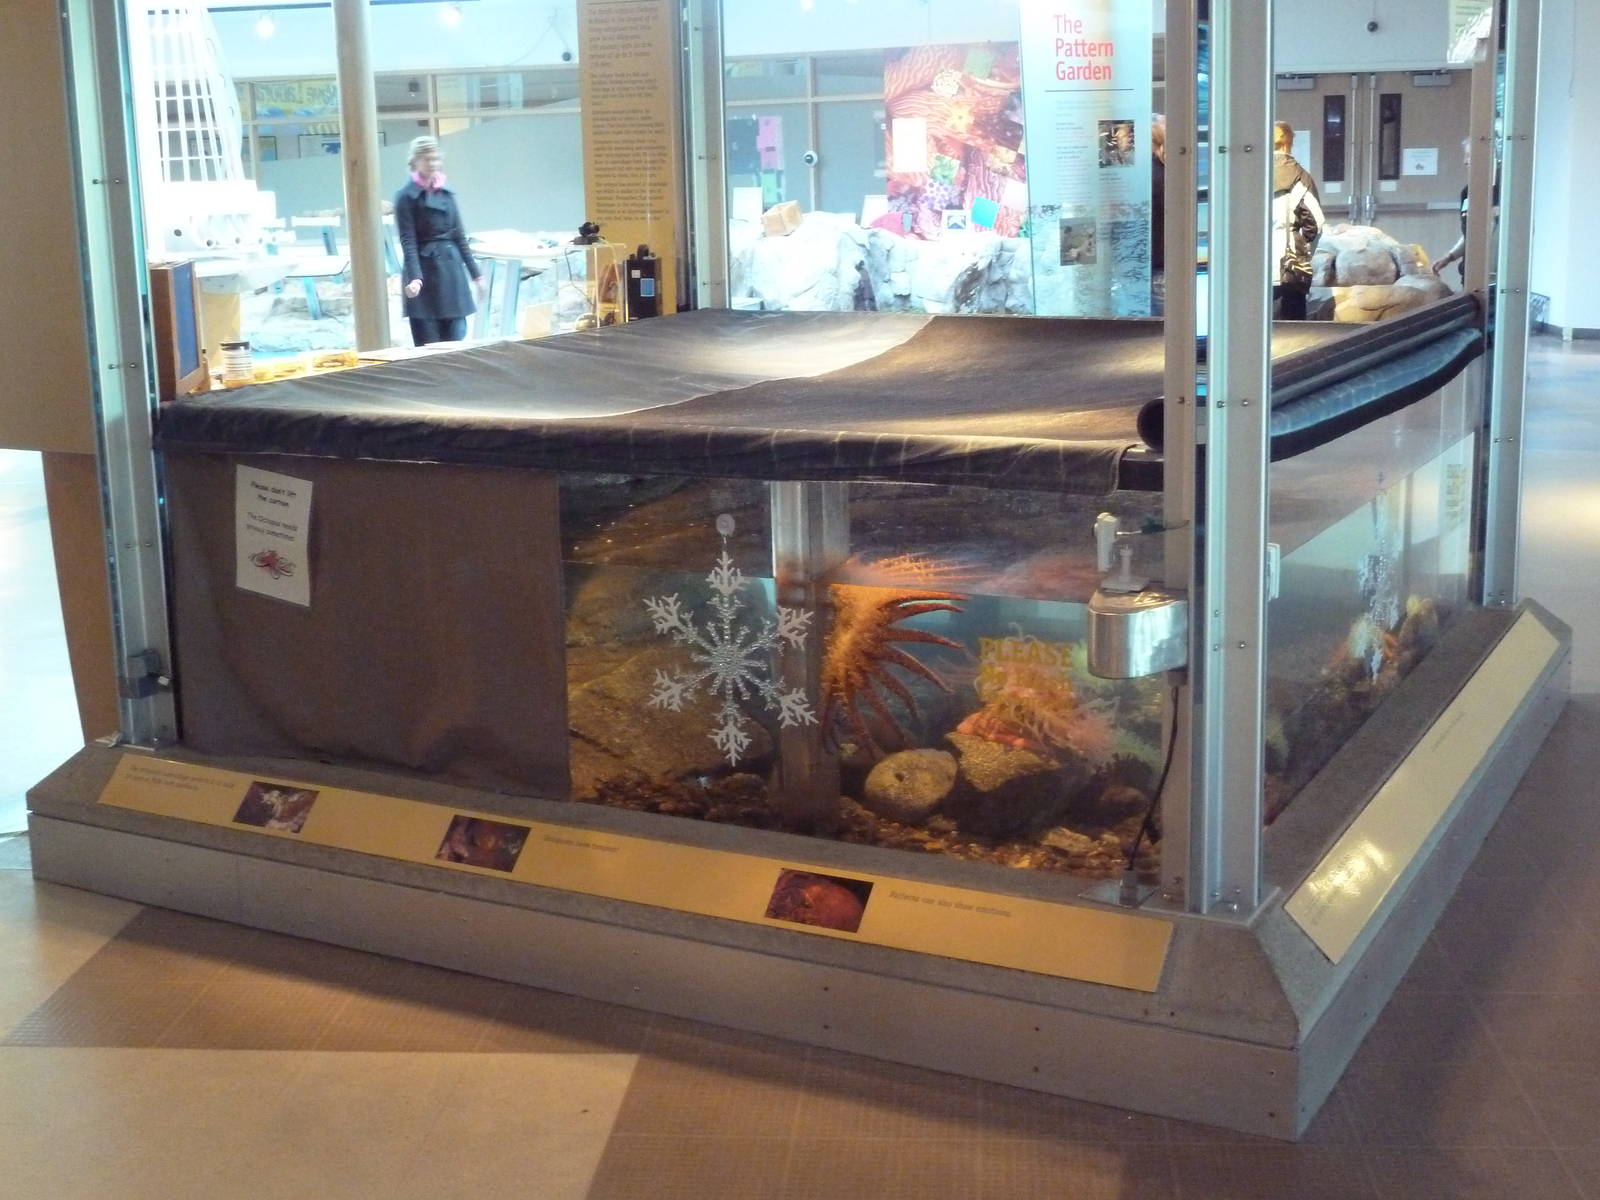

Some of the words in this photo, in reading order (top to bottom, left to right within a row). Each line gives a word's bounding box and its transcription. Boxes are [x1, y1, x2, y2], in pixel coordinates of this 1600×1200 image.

[1053, 14, 1083, 34] The
[1055, 38, 1114, 57] Pattern
[1056, 61, 1112, 81] Garden
[978, 637, 1073, 667] PLEASE
